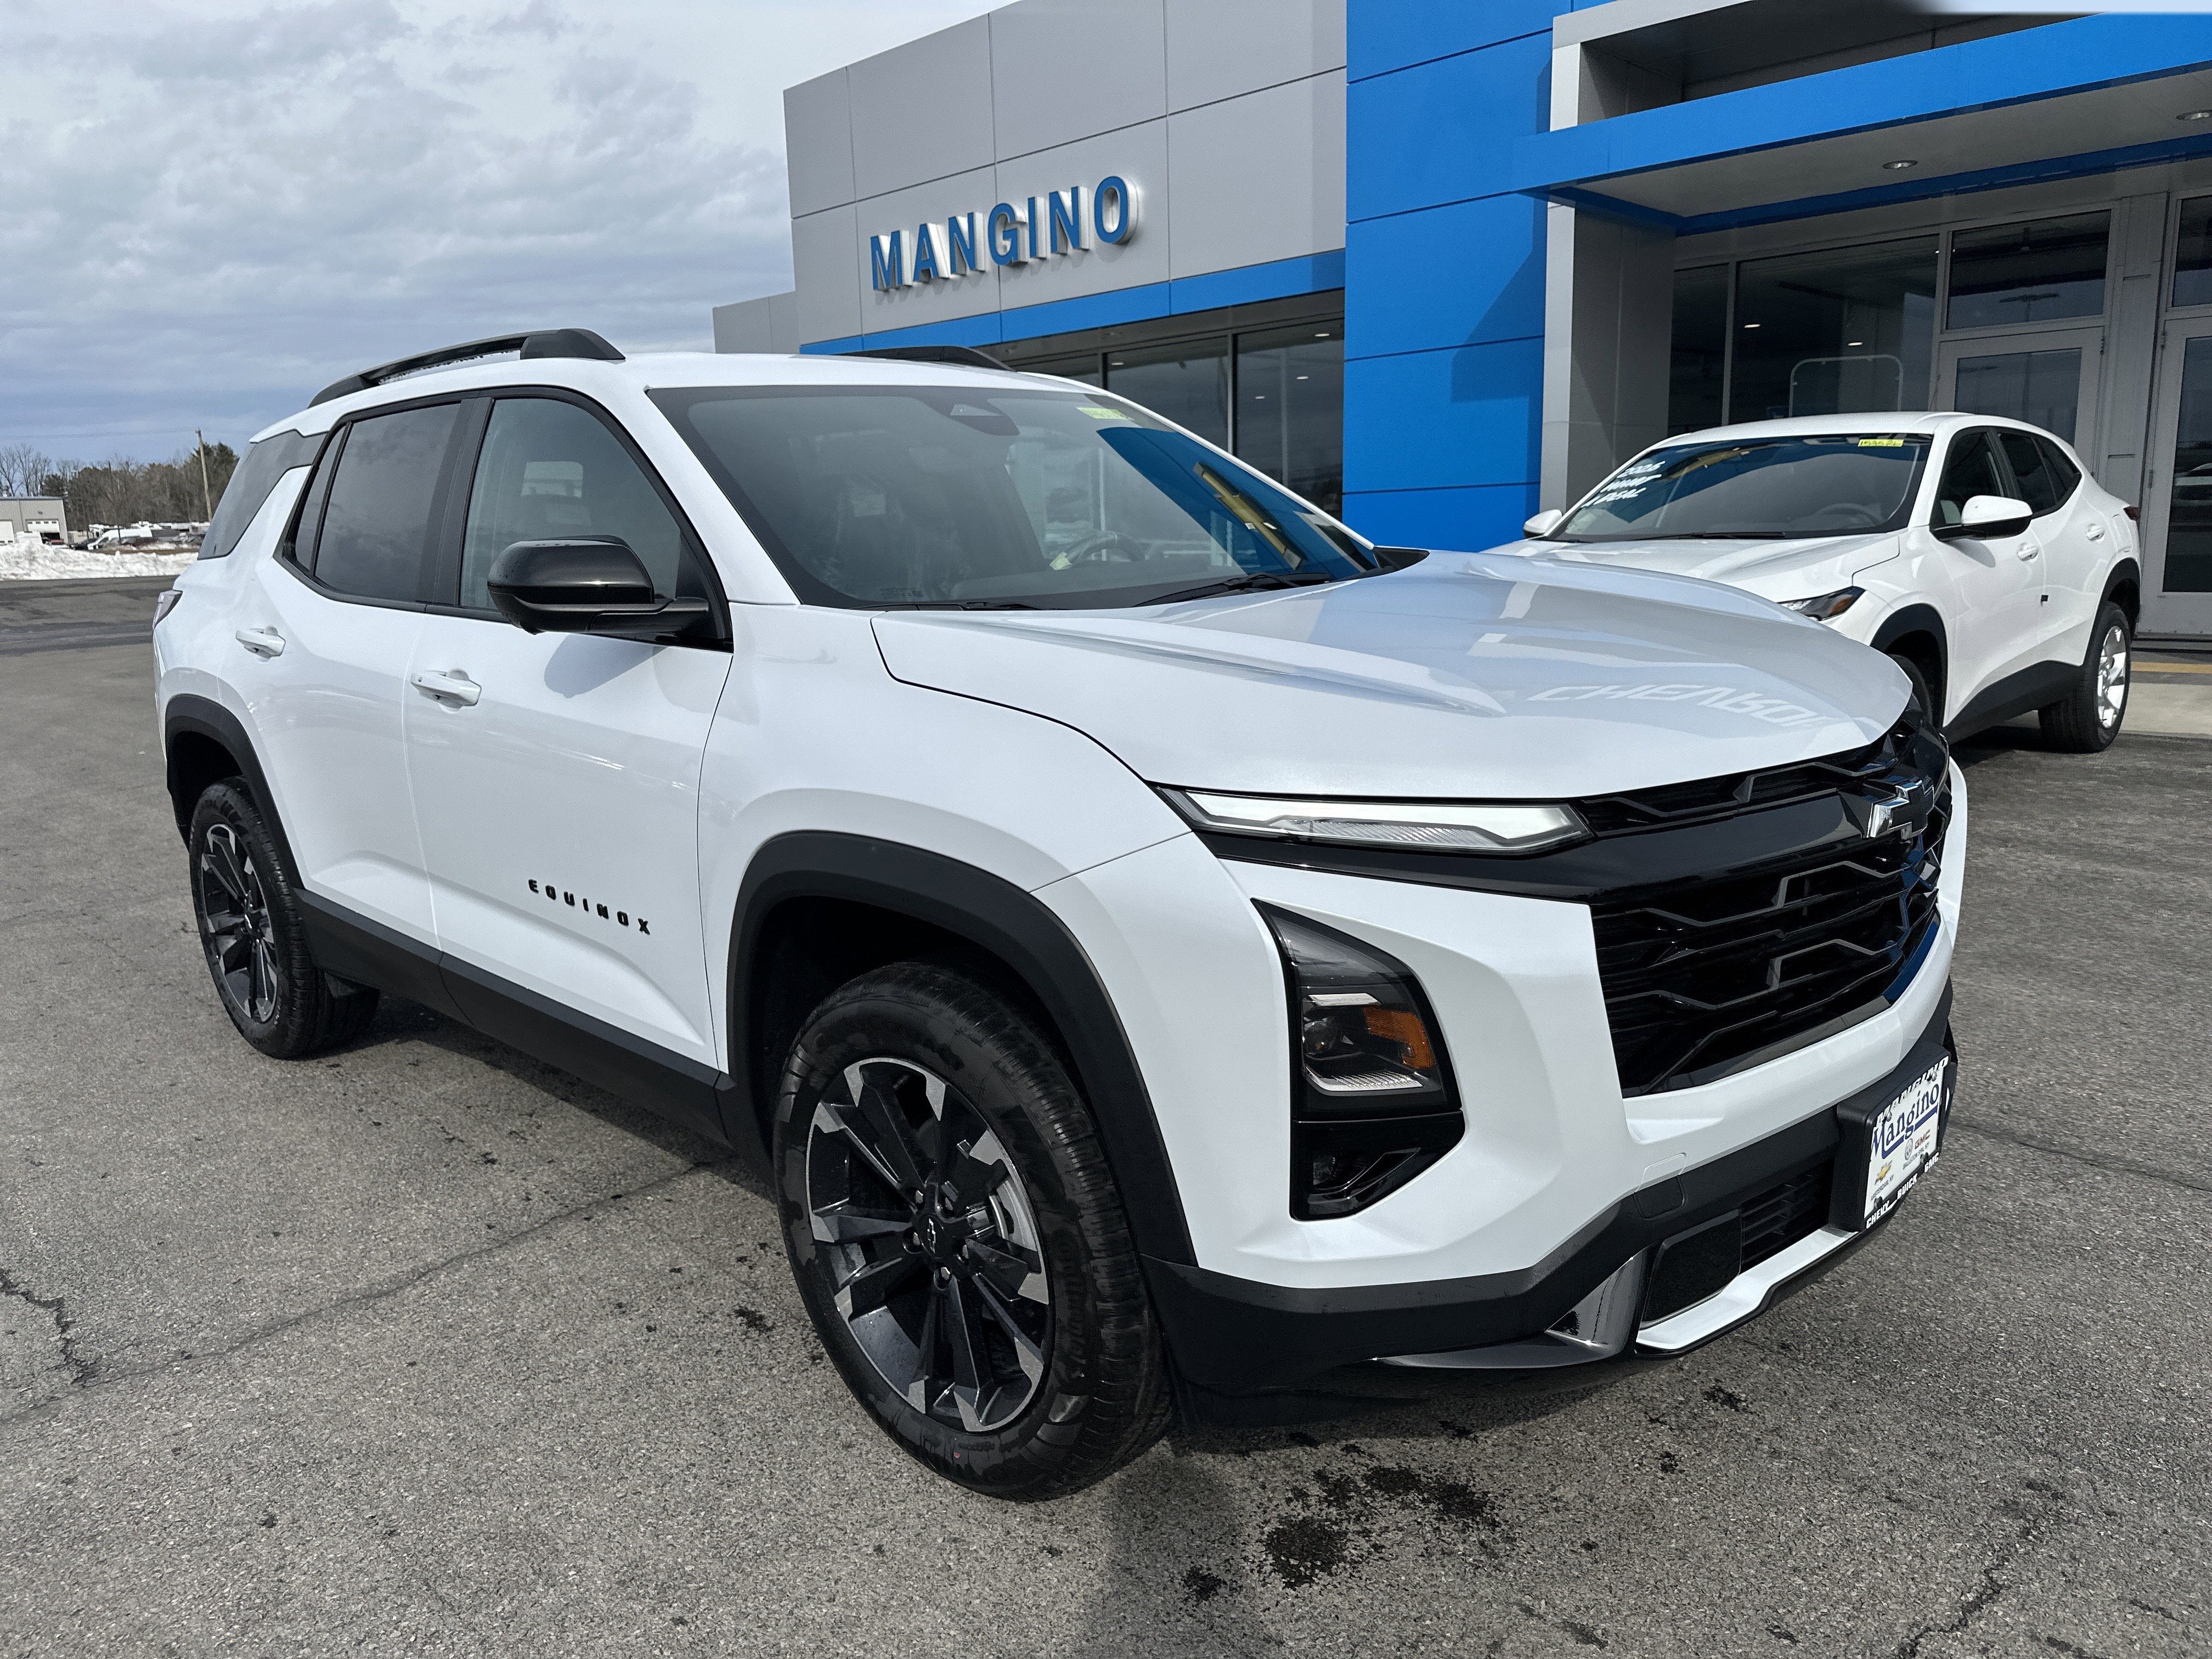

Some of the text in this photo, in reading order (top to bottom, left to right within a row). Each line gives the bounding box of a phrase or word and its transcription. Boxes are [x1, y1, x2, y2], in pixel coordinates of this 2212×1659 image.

[870, 176, 1138, 291] MANGINO
[528, 879, 650, 935] EQUINOX
[1871, 1084, 1939, 1159] Mangino
[1915, 1129, 1931, 1149] GMC
[1866, 1152, 1939, 1229] CHEVY BUICK GMC
